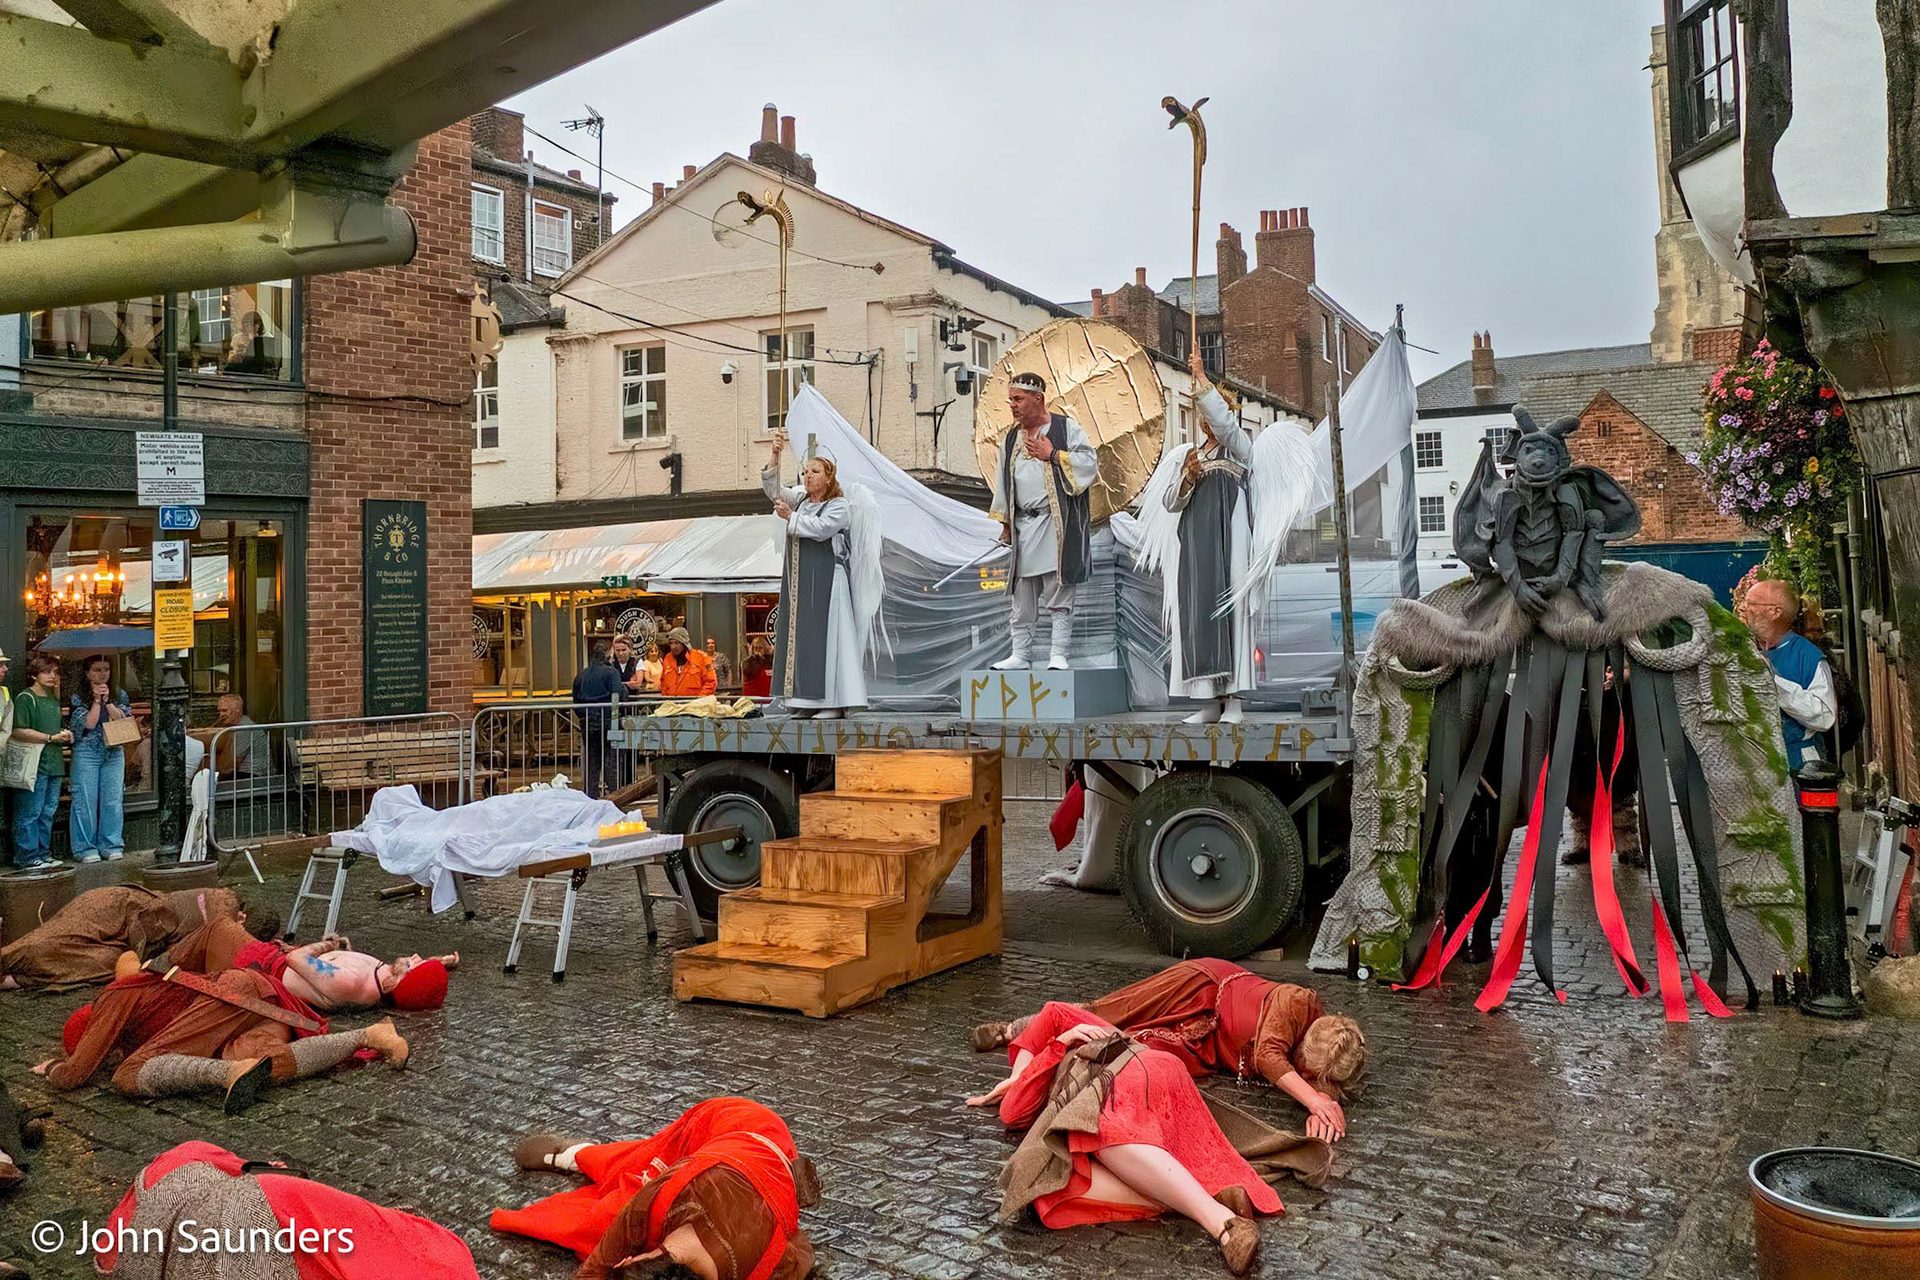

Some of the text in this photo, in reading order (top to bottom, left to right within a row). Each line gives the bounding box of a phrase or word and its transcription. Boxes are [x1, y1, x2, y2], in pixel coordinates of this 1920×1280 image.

[166, 467, 176, 476] M
[373, 513, 420, 549] THORNBRIDGE
[383, 552, 409, 564] & CO
[160, 606, 190, 614] CLOSURE
[616, 610, 638, 630] DOUGH
